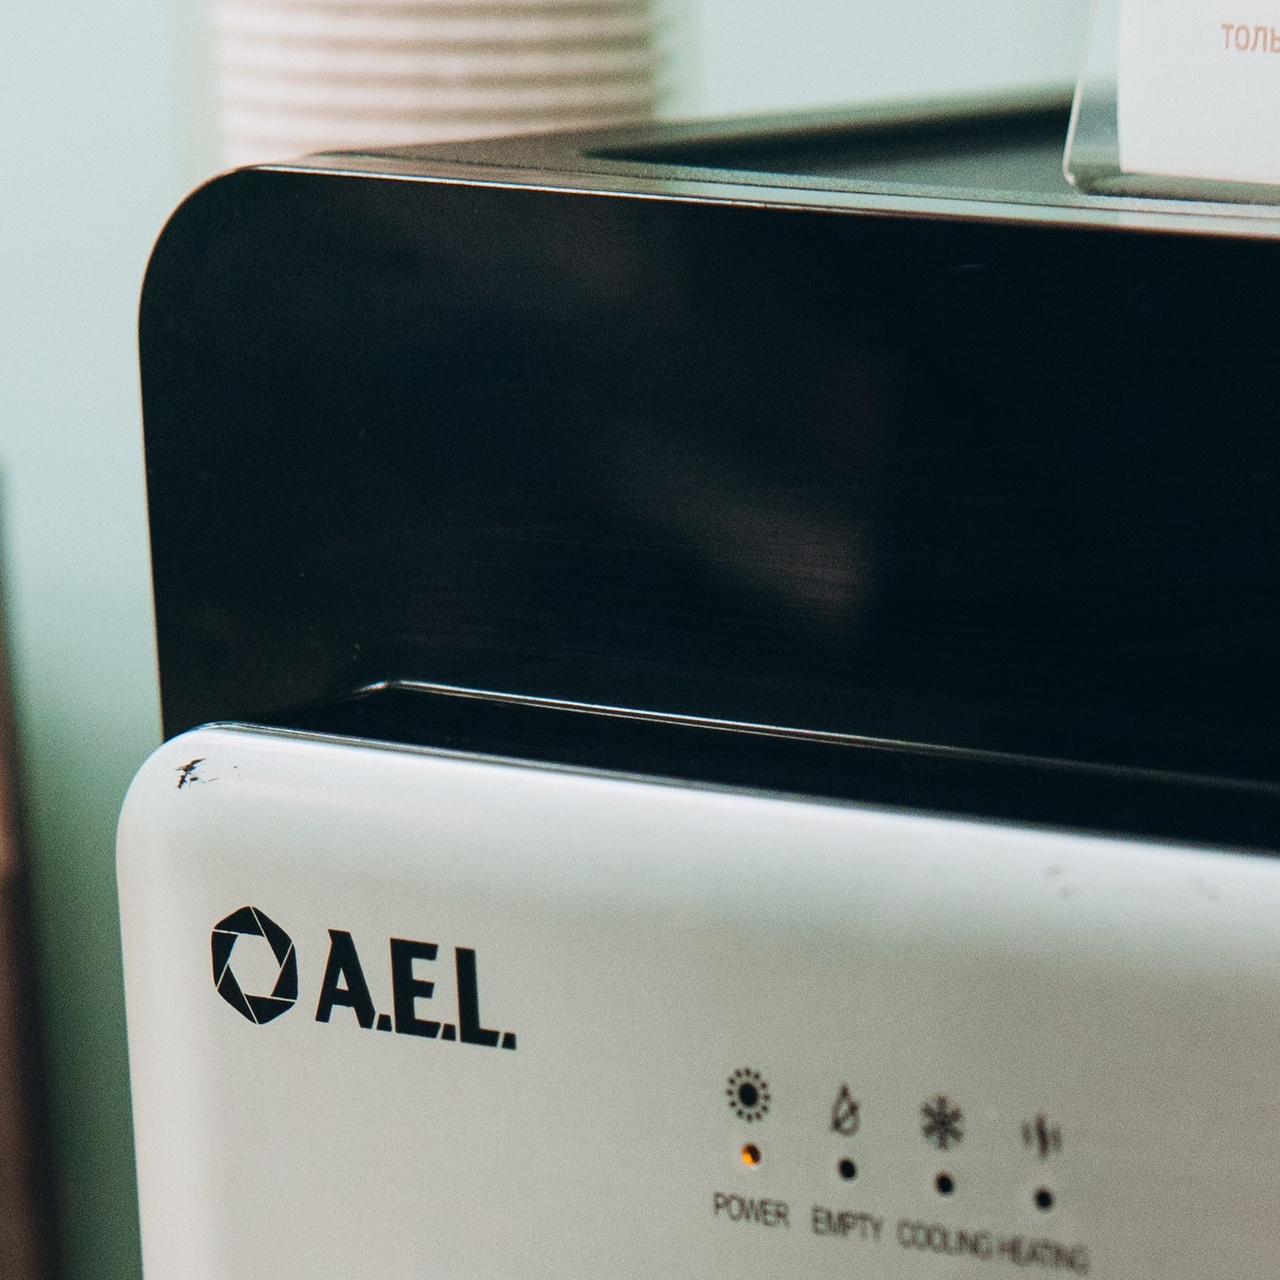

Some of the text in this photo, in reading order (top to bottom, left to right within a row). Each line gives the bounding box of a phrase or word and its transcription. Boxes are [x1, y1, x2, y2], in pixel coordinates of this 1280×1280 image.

[315, 928, 517, 1050] A.E.L.
[712, 1191, 1091, 1277] POWER EMPTY COOLING HEATING
